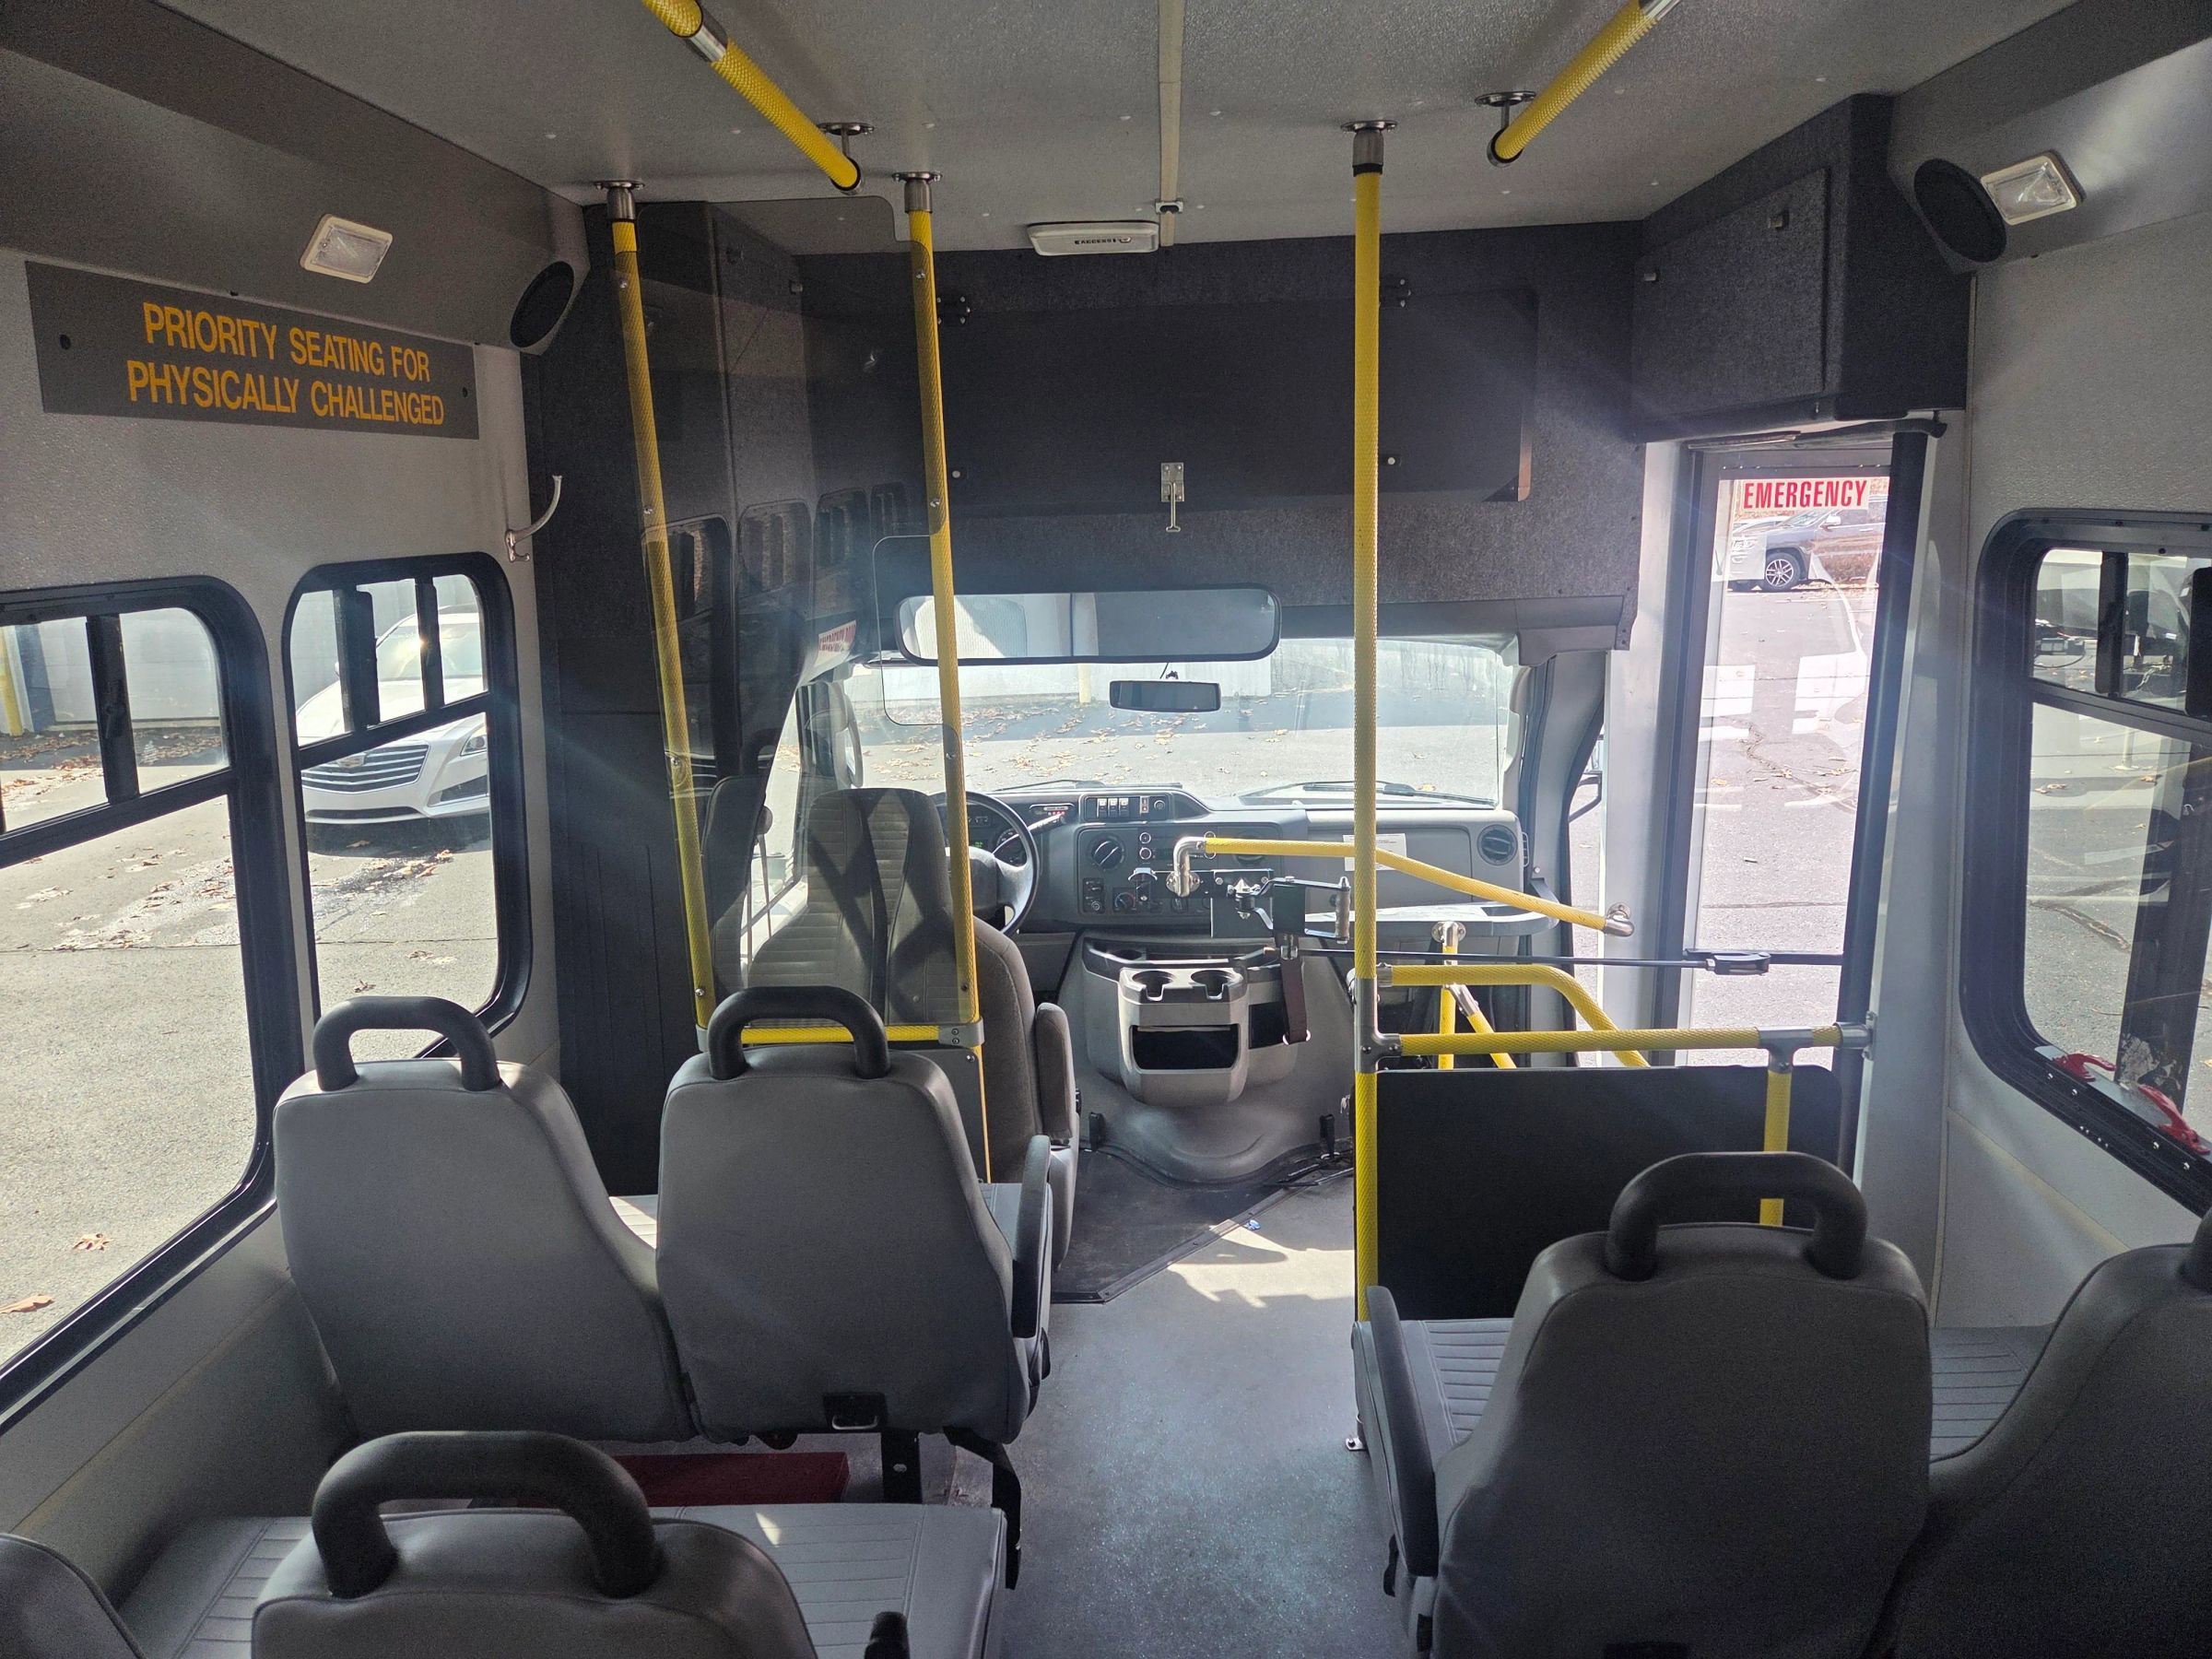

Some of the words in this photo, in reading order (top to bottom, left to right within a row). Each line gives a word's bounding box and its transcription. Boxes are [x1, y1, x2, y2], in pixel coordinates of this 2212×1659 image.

[143, 302, 276, 359] PRIORITY
[289, 327, 384, 376] SEATING
[391, 346, 430, 382] FOR
[127, 360, 300, 413] PHYSICALLY
[311, 381, 444, 425] CHALLENGED
[1744, 480, 1867, 509] EMERGENCY
